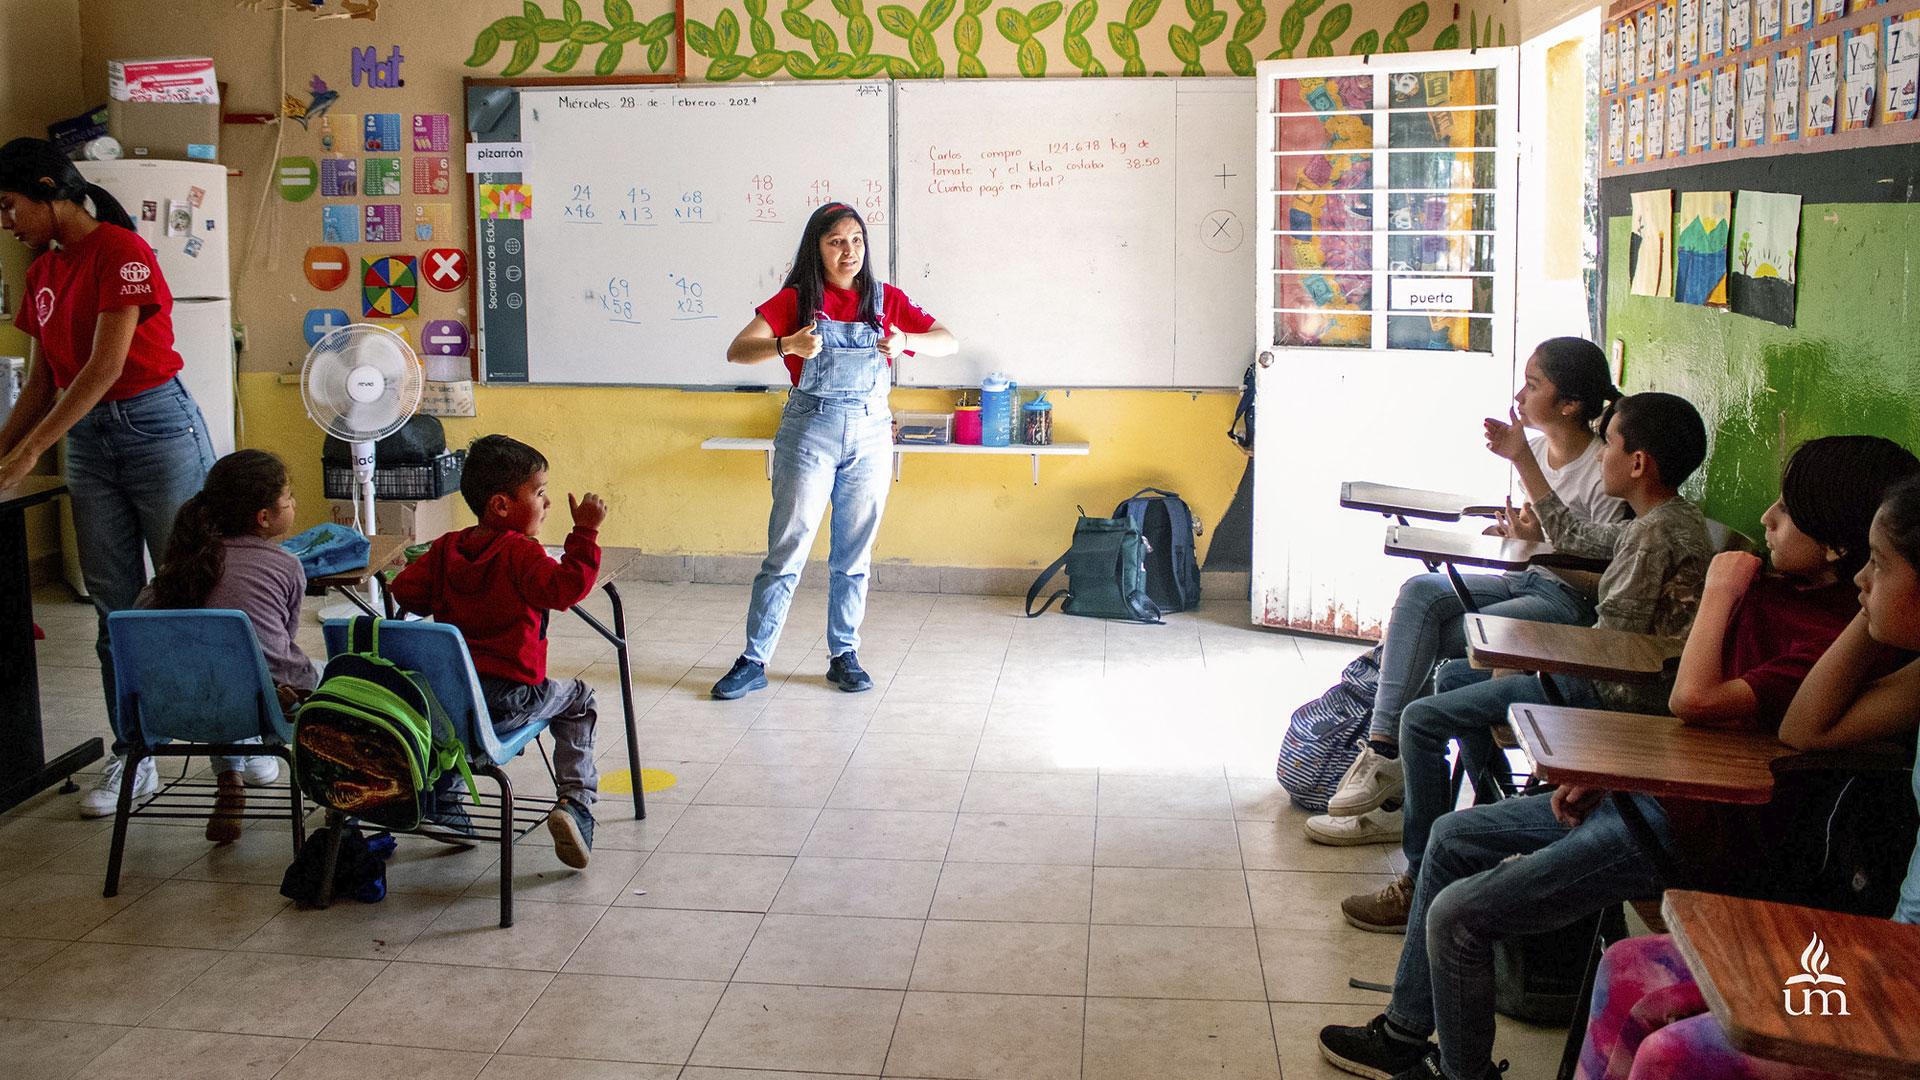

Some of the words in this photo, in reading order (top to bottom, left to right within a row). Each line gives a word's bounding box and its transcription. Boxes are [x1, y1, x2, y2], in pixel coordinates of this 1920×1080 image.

[1891, 30, 1902, 65] Z
[1849, 42, 1860, 75] Y
[1774, 64, 1788, 91] W
[1810, 54, 1820, 87] X
[1745, 72, 1755, 99] V
[620, 96, 635, 108] 28
[647, 98, 658, 107] de
[367, 116, 375, 126] 2
[414, 116, 423, 126] 3
[477, 147, 523, 160] pizarrón
[929, 145, 962, 160] Carlos
[1110, 138, 1126, 154] kg
[392, 160, 400, 170] 5
[440, 159, 448, 169] 6
[932, 162, 973, 176] tomate
[751, 174, 774, 191] 48
[810, 179, 830, 194] 49
[571, 184, 591, 200] 24
[627, 187, 651, 203] 45
[682, 190, 703, 204] 68
[367, 206, 375, 216] 8
[416, 206, 423, 216] 9
[755, 207, 776, 218] 25
[867, 211, 884, 223] 60
[486, 246, 496, 258] de
[120, 284, 152, 295] ADRA
[486, 261, 498, 309] Secretaría
[608, 276, 629, 298] 69
[675, 277, 703, 297] 40
[1410, 292, 1453, 306] puerta
